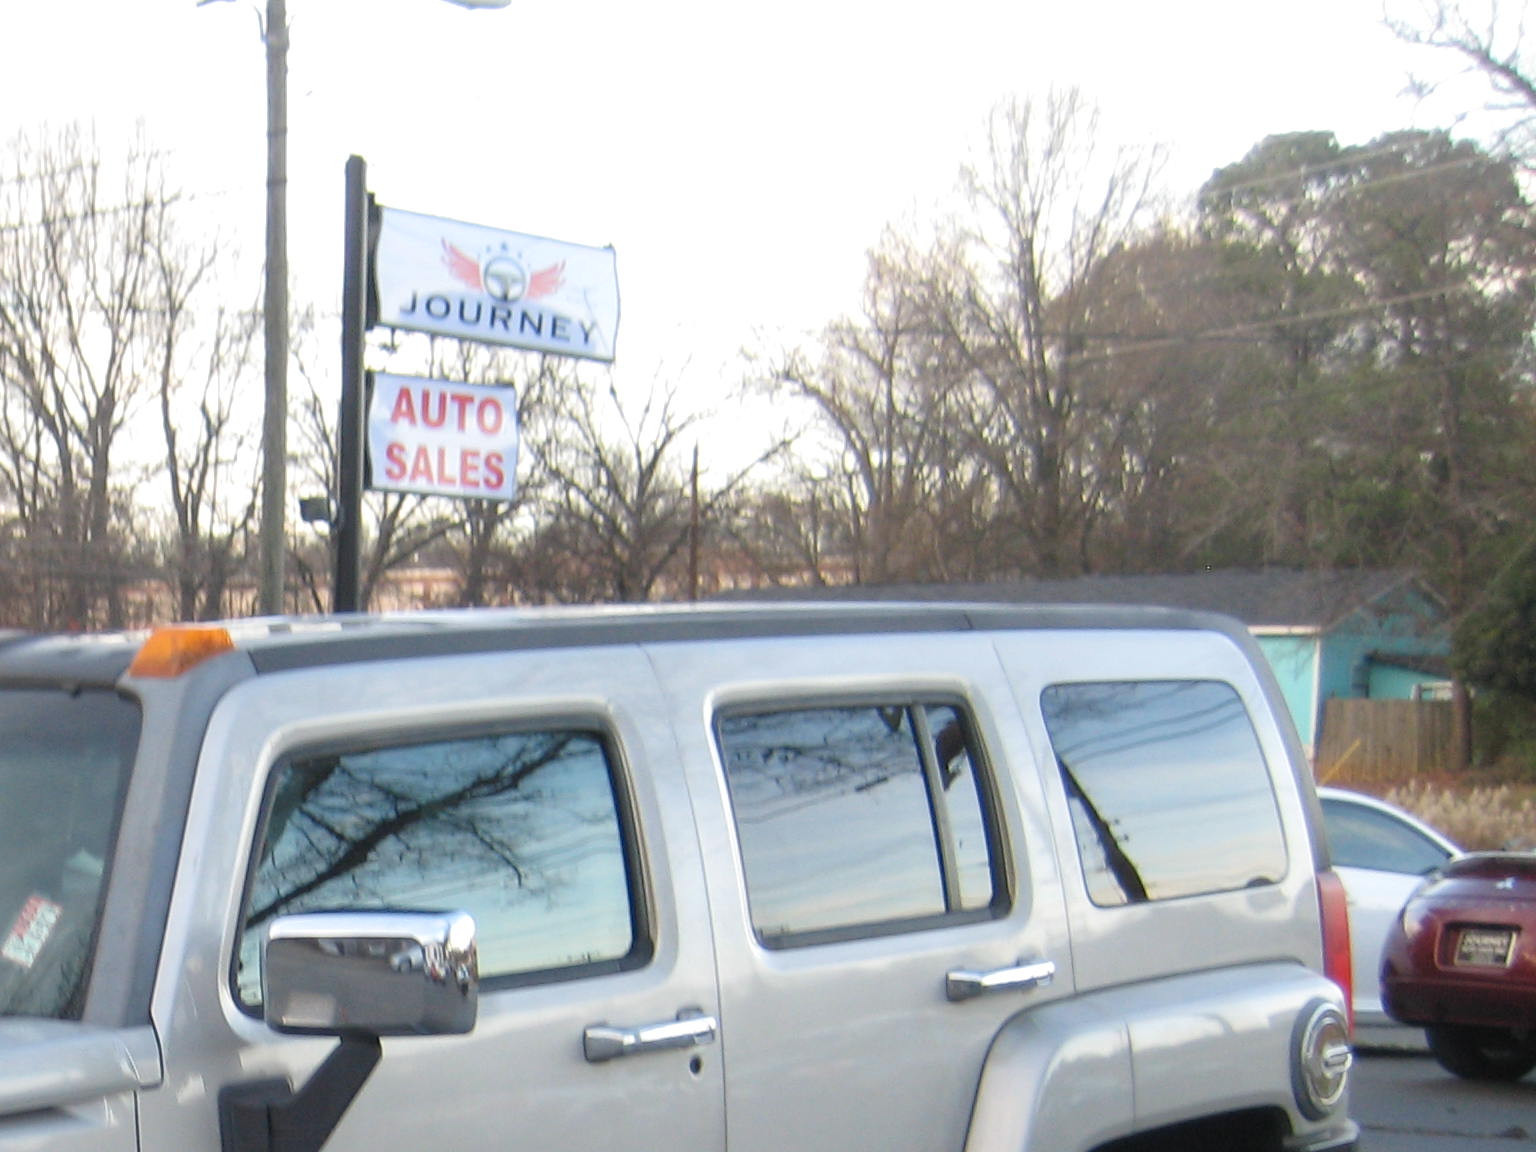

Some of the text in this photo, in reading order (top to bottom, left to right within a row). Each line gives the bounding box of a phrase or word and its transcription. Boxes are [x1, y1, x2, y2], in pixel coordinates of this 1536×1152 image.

[399, 290, 599, 345] JOURNEY
[390, 385, 504, 435] AUTO
[384, 441, 505, 491] SALES
